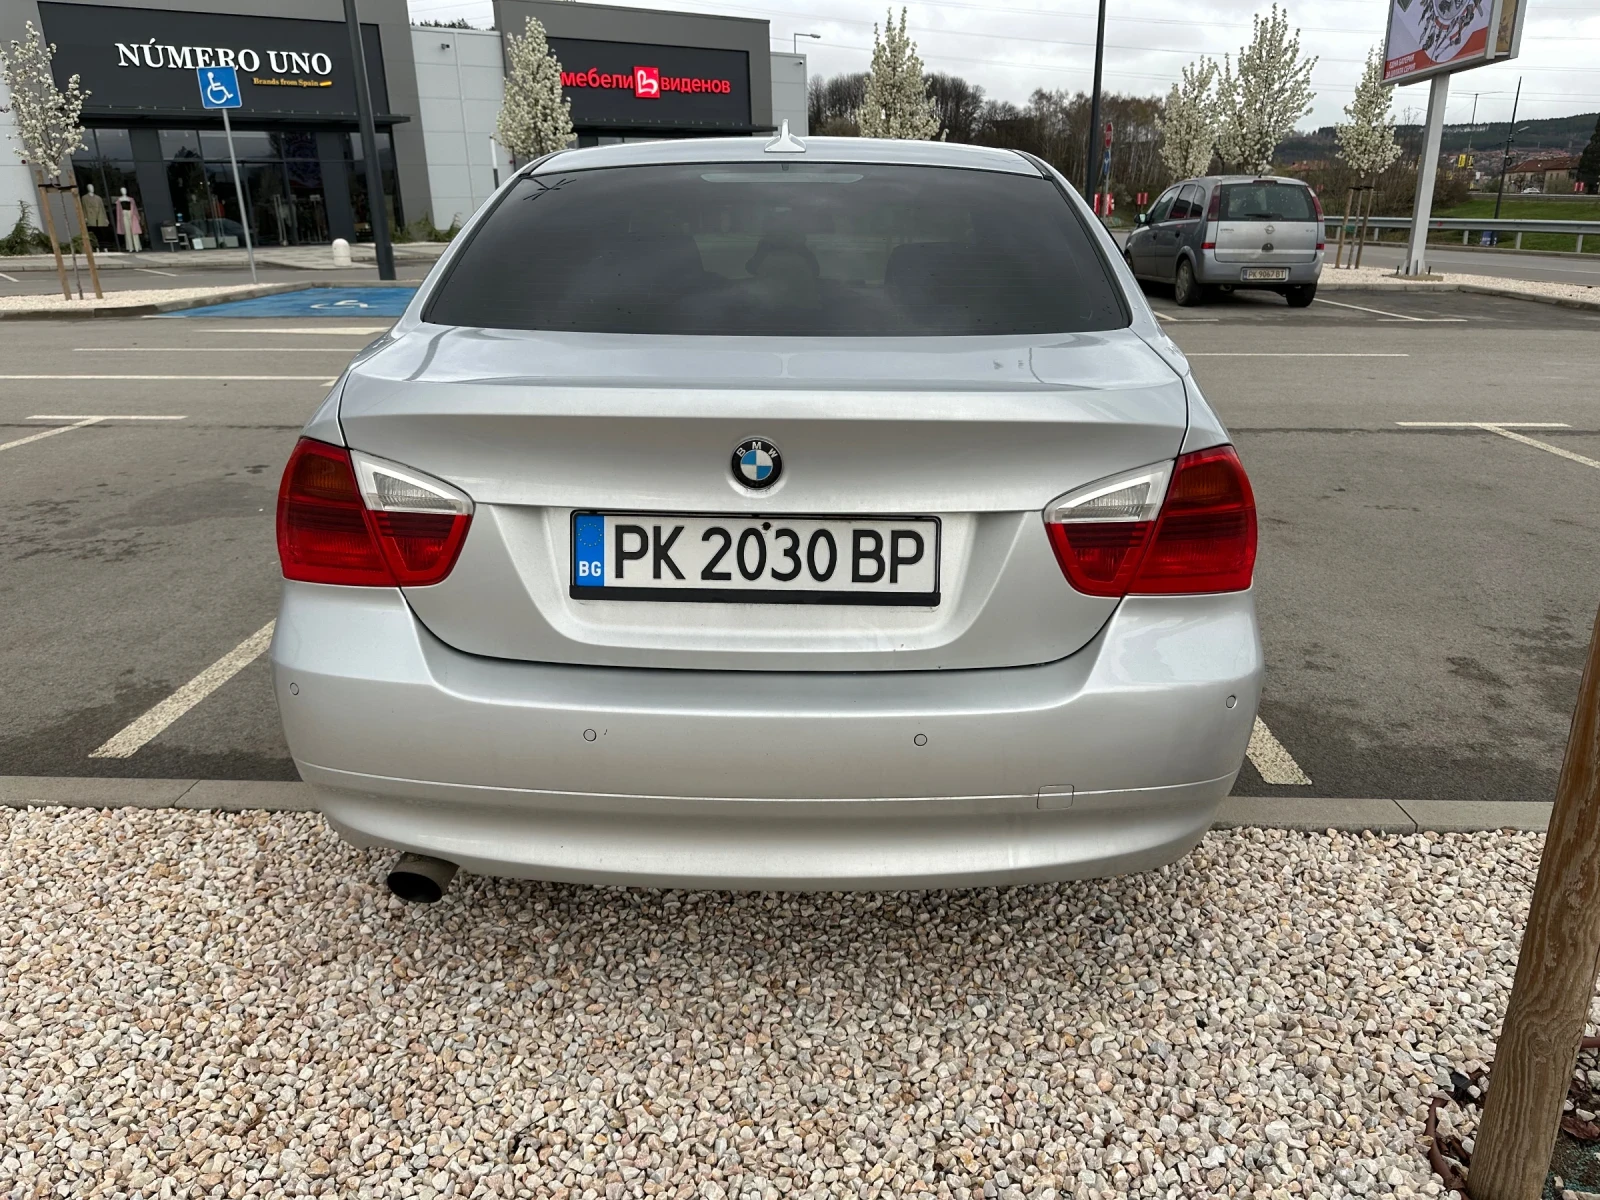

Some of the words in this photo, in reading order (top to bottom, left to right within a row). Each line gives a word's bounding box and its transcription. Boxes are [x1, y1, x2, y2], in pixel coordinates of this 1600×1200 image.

[115, 38, 260, 73] NÚMERO
[266, 50, 332, 75] UNO
[253, 77, 279, 85] Brands
[280, 78, 298, 86] from
[298, 79, 319, 88] Spain
[561, 67, 634, 89] мебели
[660, 76, 731, 94] виденов
[1258, 270, 1275, 278] 9067
[1275, 270, 1284, 278] BT
[736, 441, 778, 458] BMW
[614, 524, 686, 581] PK
[700, 526, 838, 583] 2030
[851, 529, 925, 584] BP
[578, 560, 602, 577] BG
